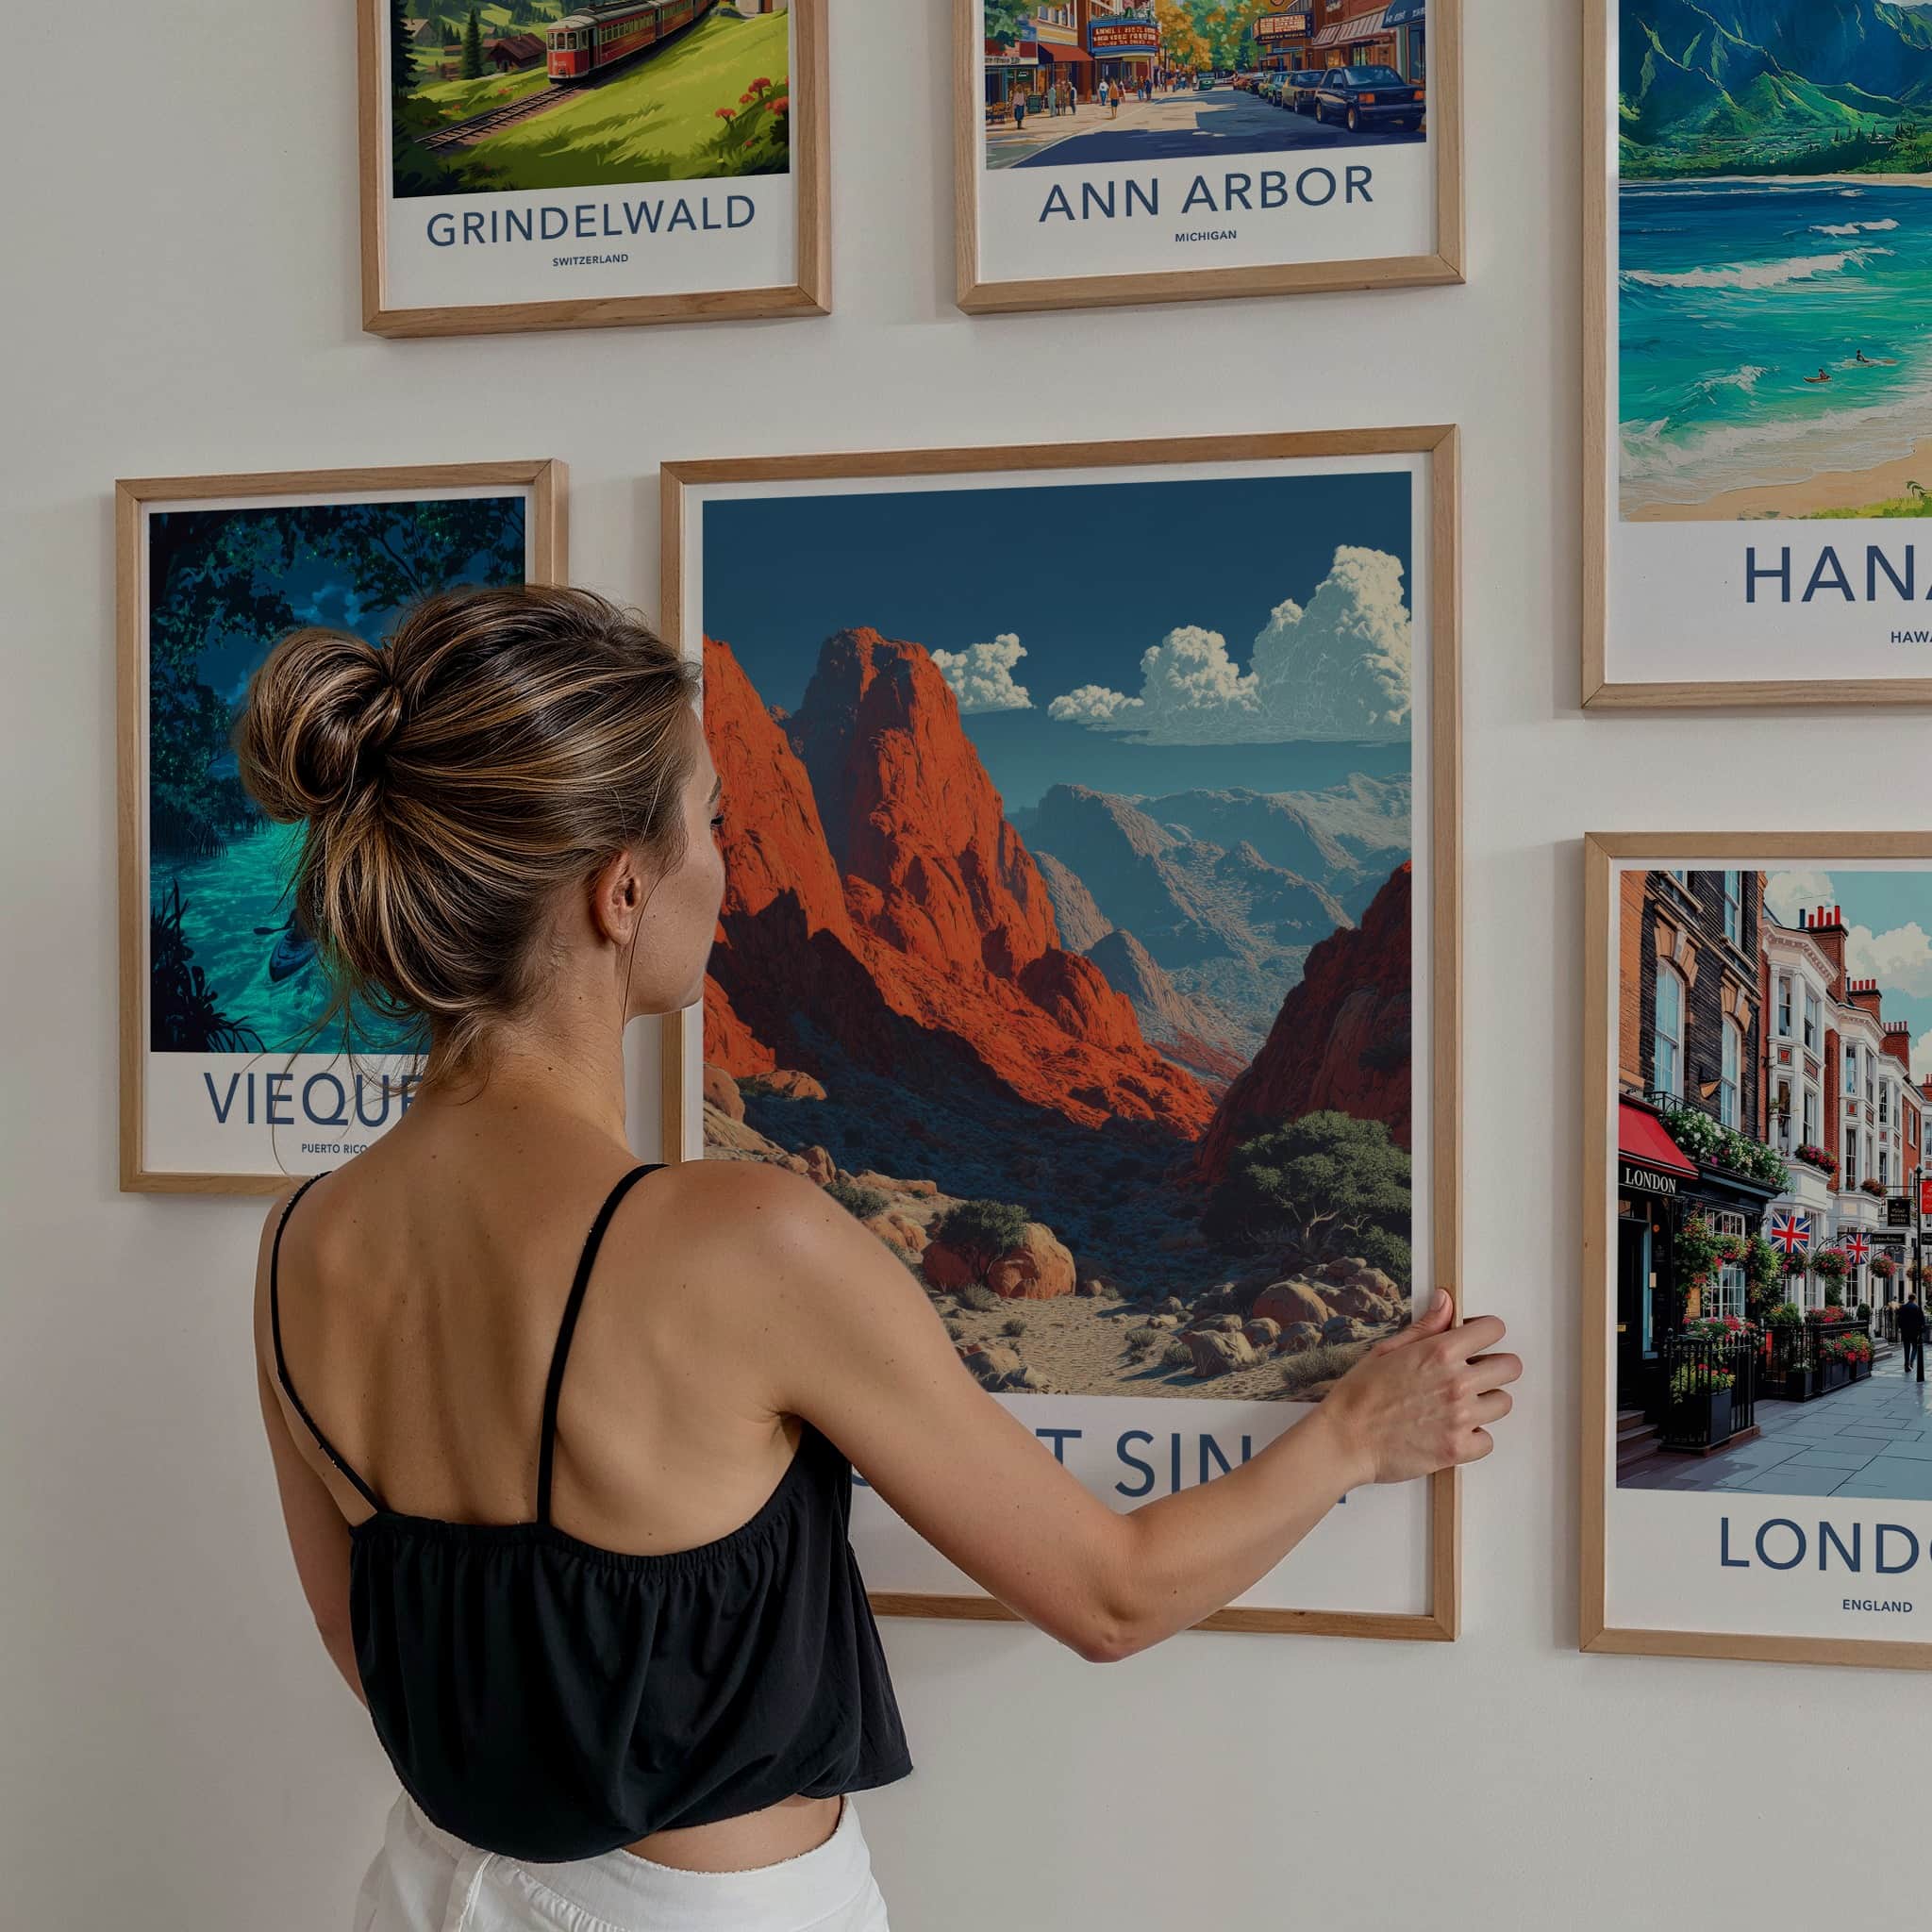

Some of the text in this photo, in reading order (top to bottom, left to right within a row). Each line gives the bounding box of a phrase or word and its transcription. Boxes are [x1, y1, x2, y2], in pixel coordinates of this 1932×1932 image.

[1039, 165, 1374, 223] ANN ARBOR
[426, 194, 756, 247] GRINDELWALD
[1174, 229, 1238, 242] MICHIGAN
[552, 253, 629, 267] SWITZERLAND
[1745, 544, 1932, 604] HAN
[1890, 630, 1932, 643] HAW
[301, 1143, 341, 1154] PUERTO
[1624, 1167, 1676, 1194] LONDON
[1721, 1517, 1932, 1574] LOND
[1842, 1599, 1913, 1613] ENGLAND
